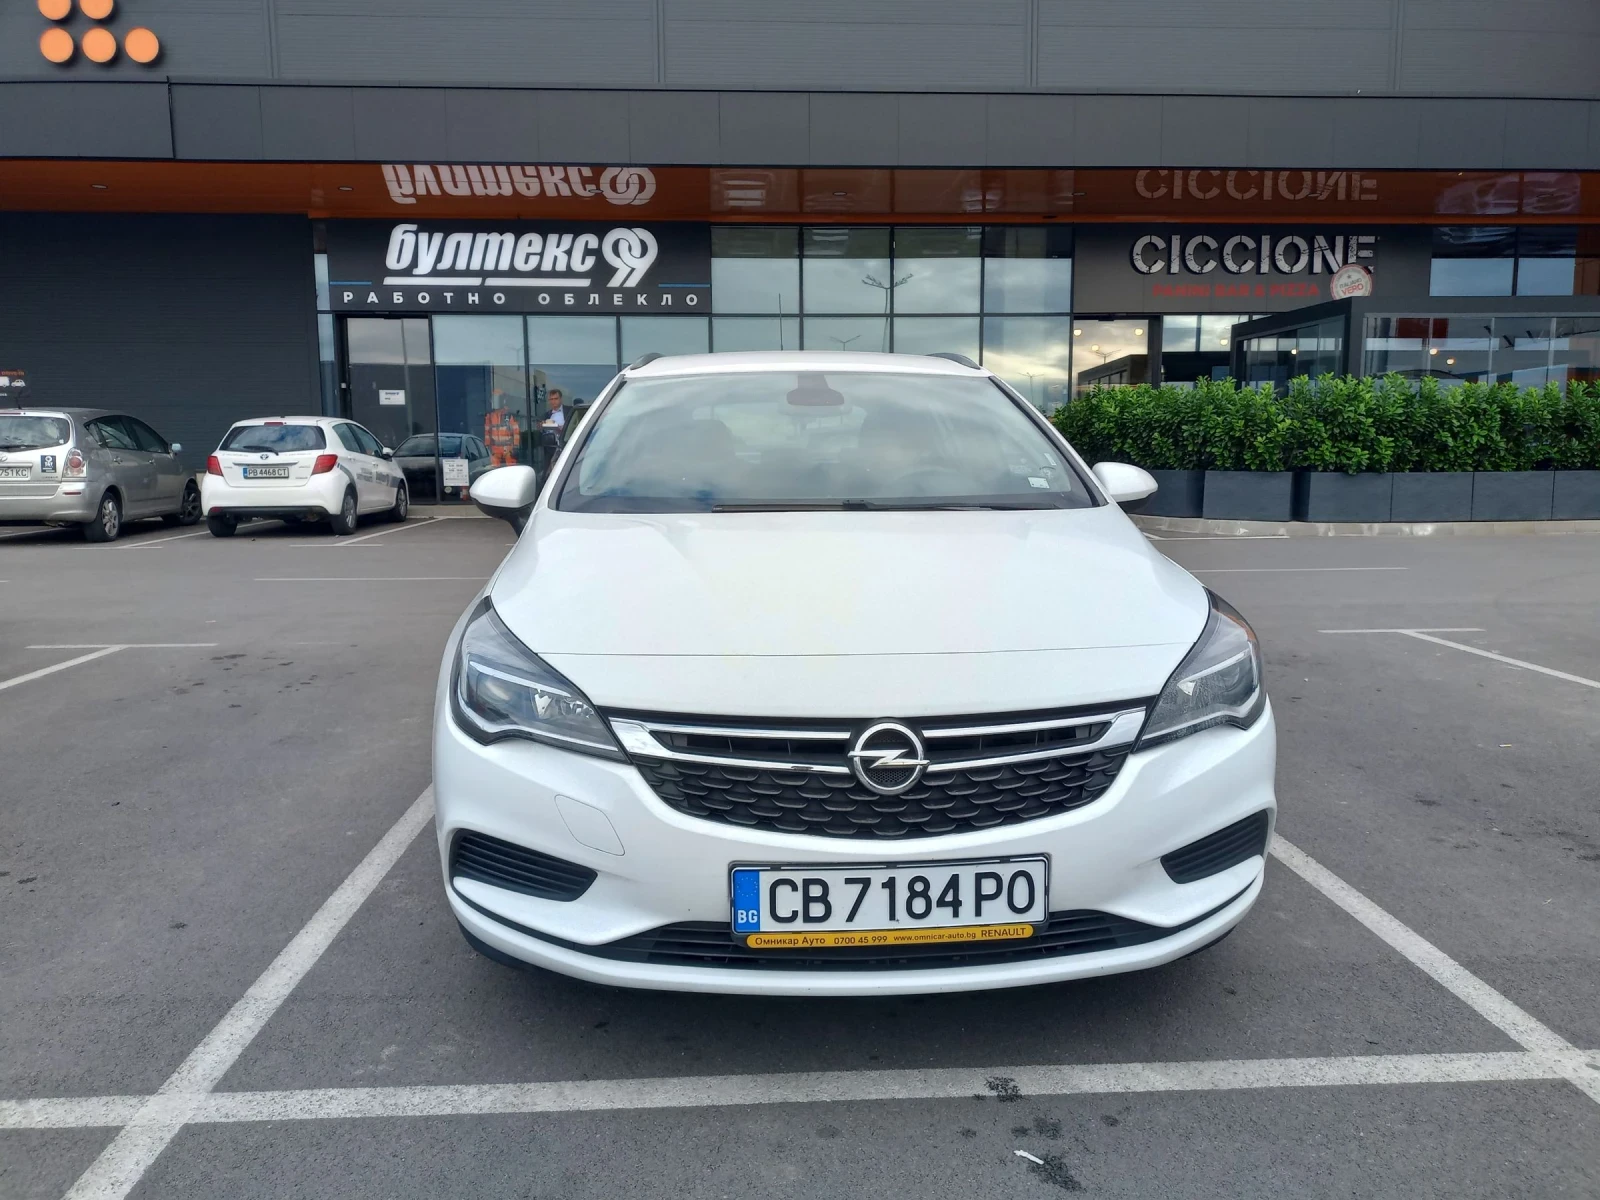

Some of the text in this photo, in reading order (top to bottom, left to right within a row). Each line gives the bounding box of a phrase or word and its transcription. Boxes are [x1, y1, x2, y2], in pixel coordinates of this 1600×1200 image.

[1132, 235, 1376, 274] CICCIONE
[1269, 283, 1320, 296] PIZZA
[1341, 283, 1364, 296] VERO
[343, 291, 698, 306] РАБОТНО ОБЛЕКЛО
[737, 909, 758, 924] BG
[755, 927, 1027, 946] Омникар Ауто 0700 45 999 www.omnicar-auto.bg RENAULT
